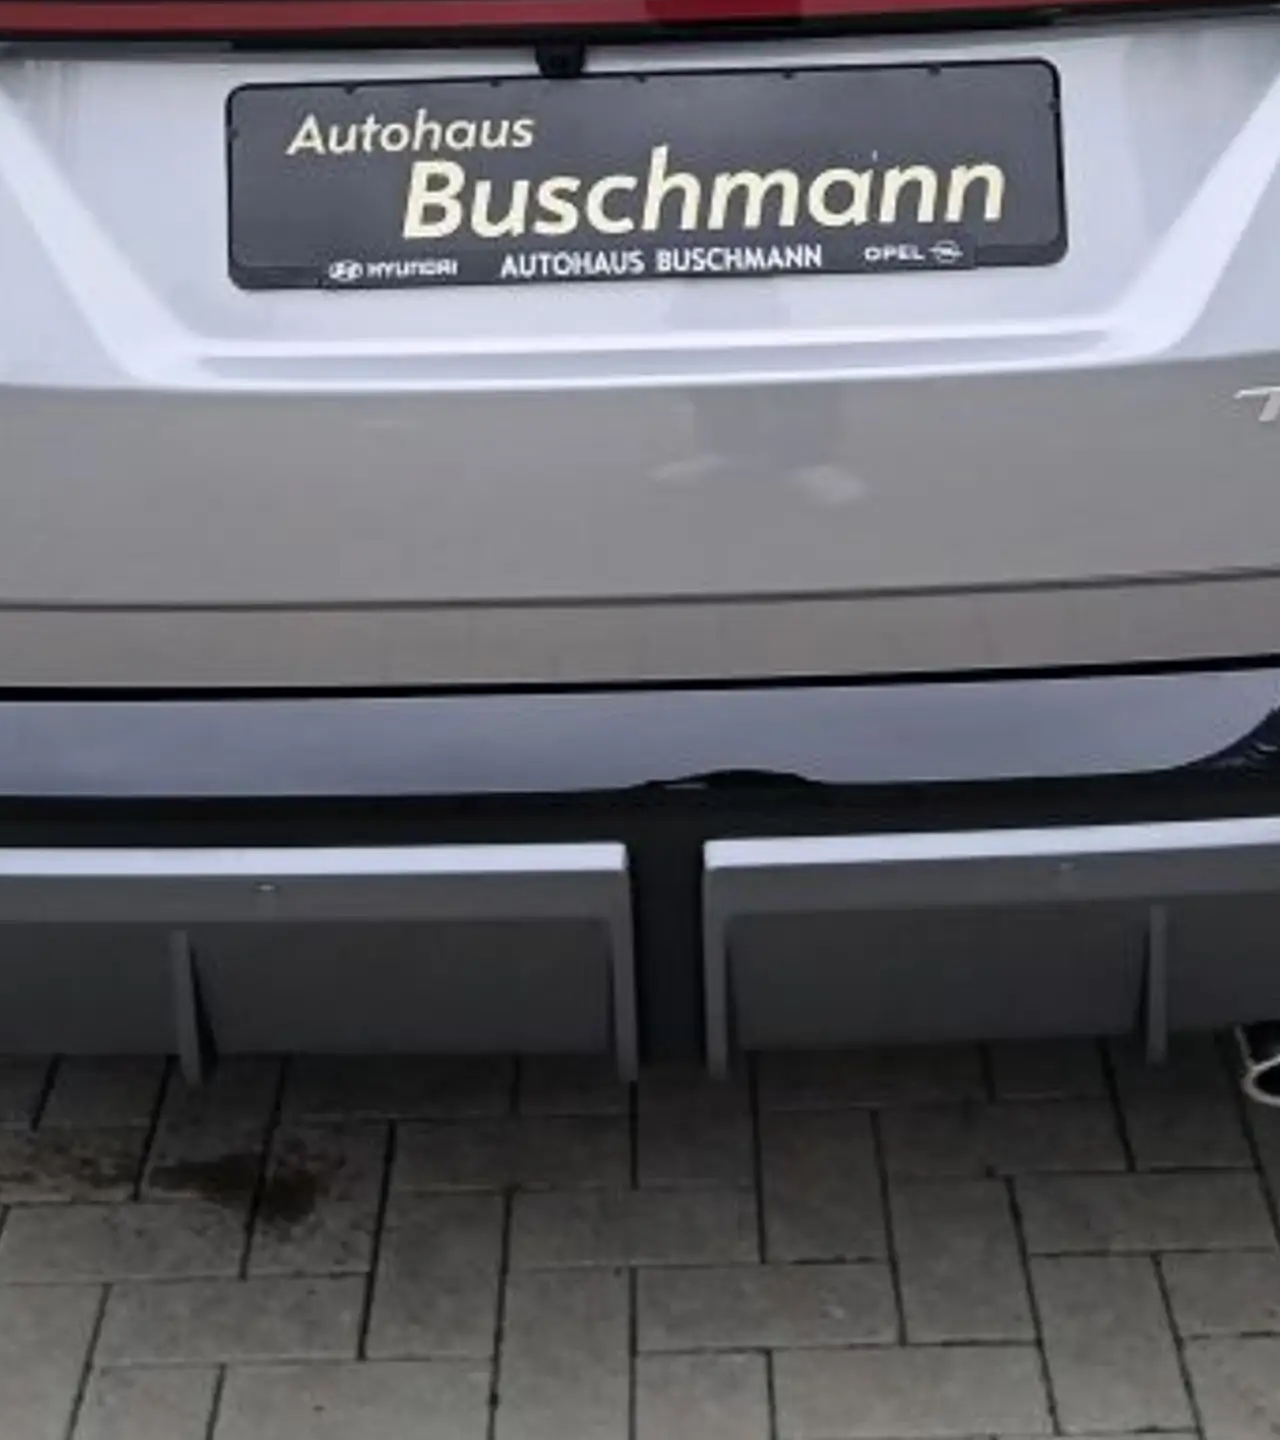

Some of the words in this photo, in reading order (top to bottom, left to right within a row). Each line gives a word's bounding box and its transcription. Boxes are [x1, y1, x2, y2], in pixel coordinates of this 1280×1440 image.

[285, 108, 536, 155] Autohaus
[402, 145, 1006, 240] Buschmann
[366, 258, 458, 279] HYUNDAI
[500, 251, 645, 280] AUTOHAUS
[656, 244, 823, 273] BUSCHMANN
[863, 245, 926, 261] OPEL
